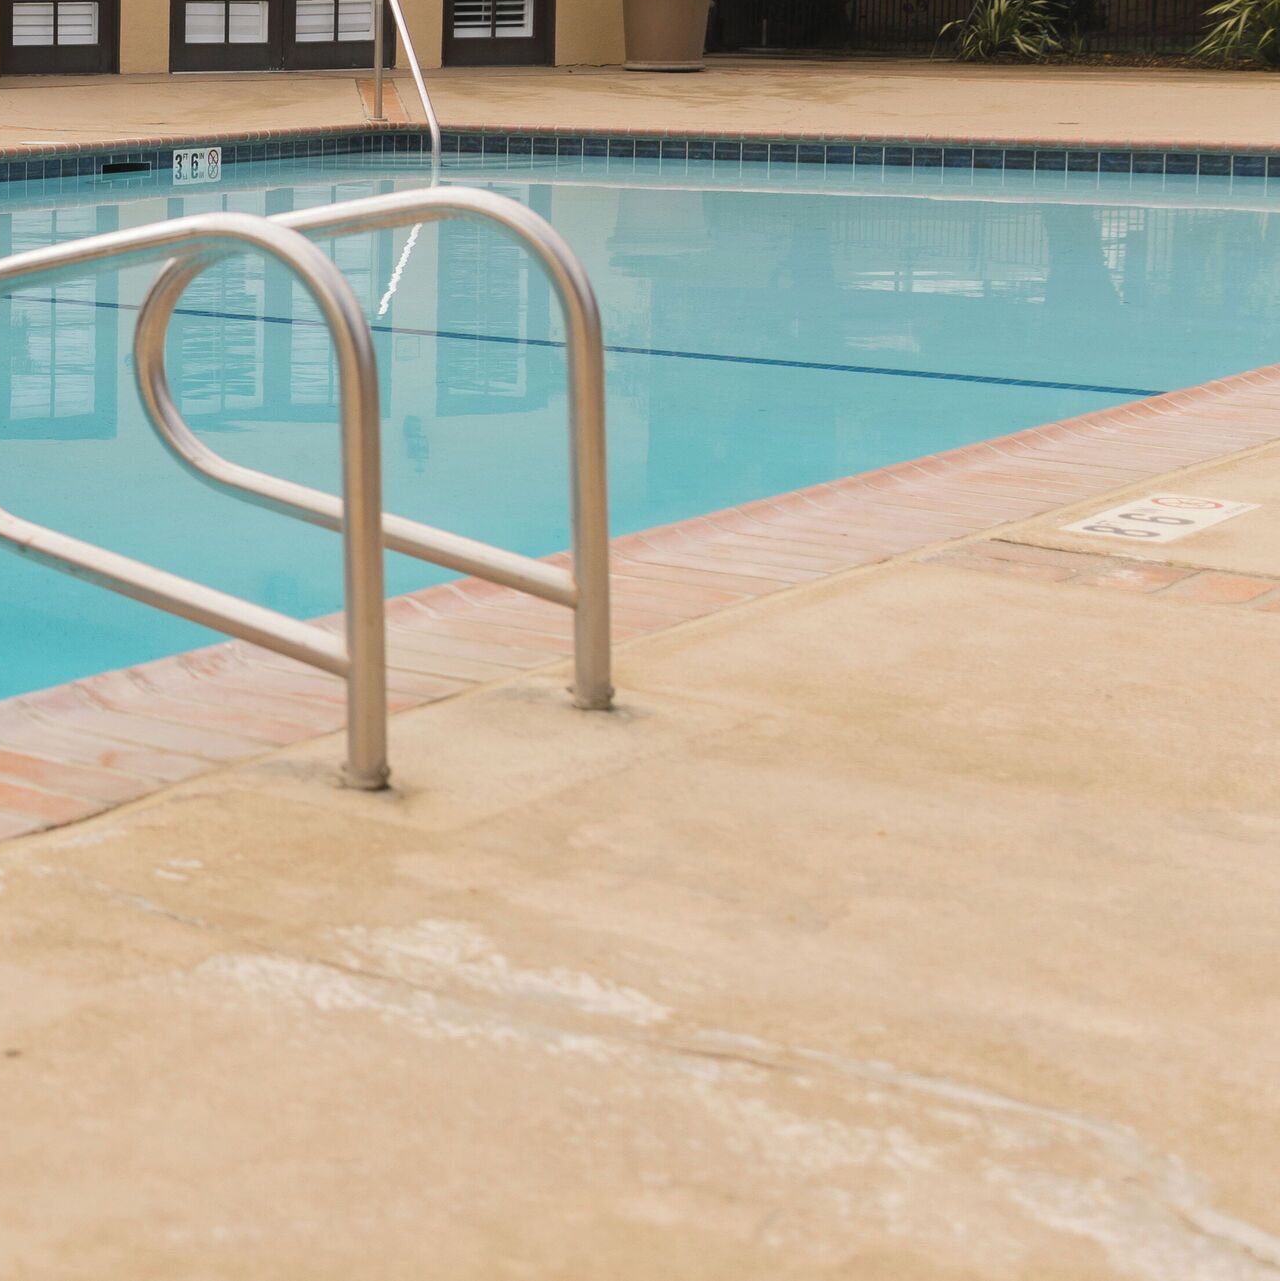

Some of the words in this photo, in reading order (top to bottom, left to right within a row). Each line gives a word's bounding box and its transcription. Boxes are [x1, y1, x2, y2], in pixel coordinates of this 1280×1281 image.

[175, 154, 182, 169] 3
[191, 153, 199, 169] 6
[199, 152, 205, 160] IN
